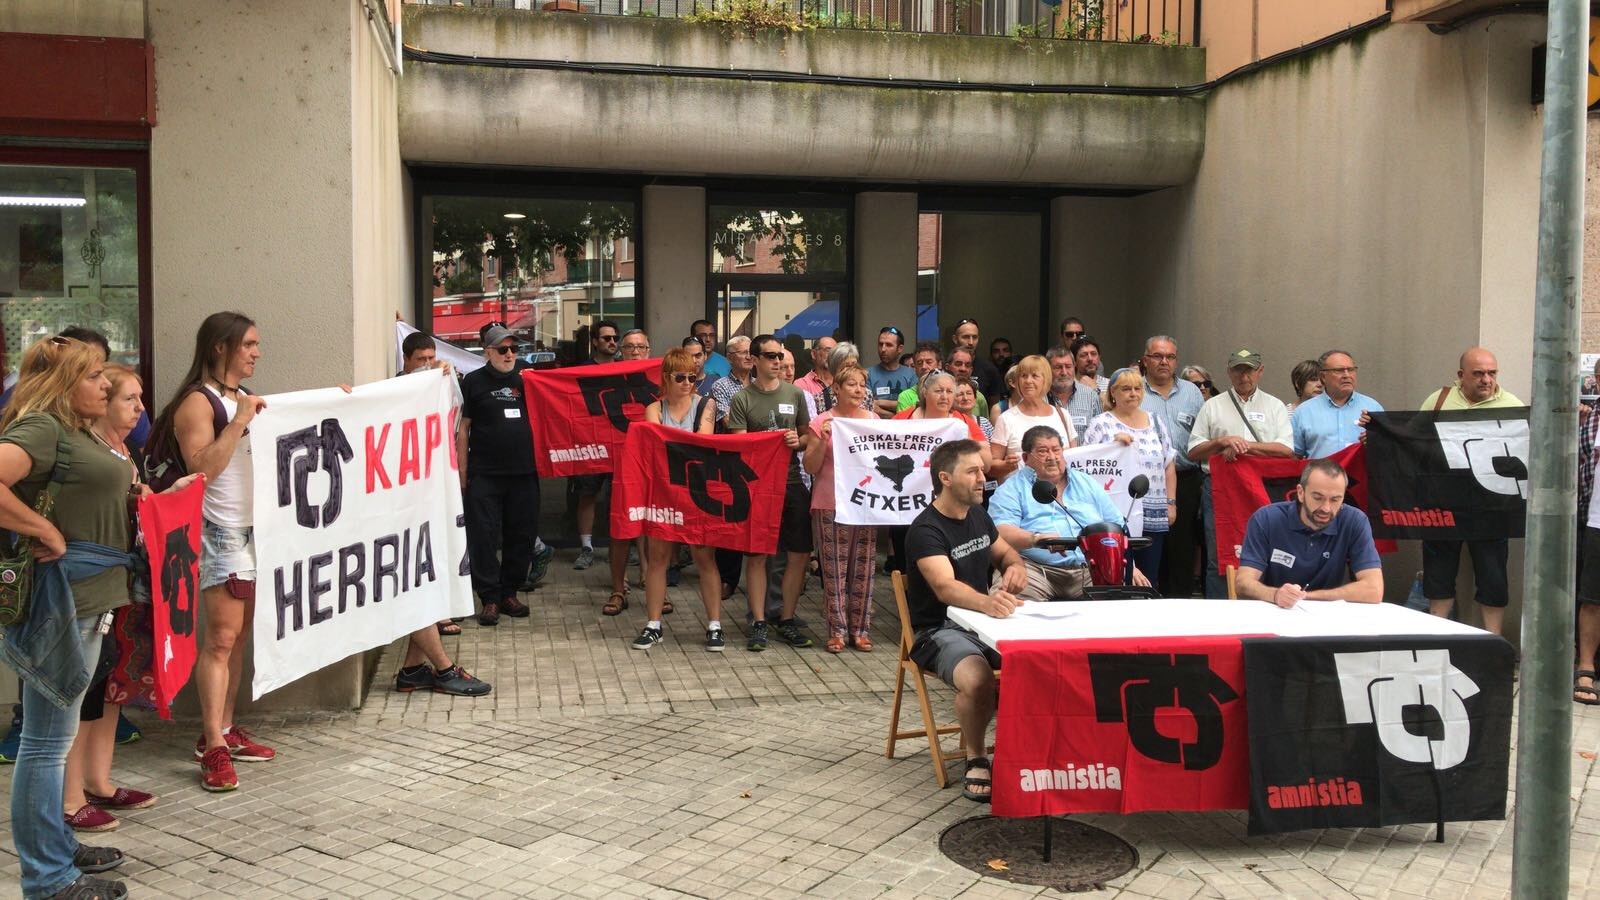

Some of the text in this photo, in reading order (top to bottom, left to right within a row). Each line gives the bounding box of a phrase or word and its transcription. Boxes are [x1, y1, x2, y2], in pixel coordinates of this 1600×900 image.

[715, 231, 843, 247] MIRAVALES 8
[848, 444, 870, 454] ETA
[853, 433, 943, 445] EUSKAL PRESO
[549, 443, 609, 463] amnistia
[1070, 459, 1118, 469] AL PRESO
[628, 504, 684, 527] amnistia
[1381, 507, 1456, 527] amnistia
[274, 520, 436, 641] HERRIA
[1020, 762, 1122, 792] amnistia
[1267, 777, 1363, 809] amnistia
